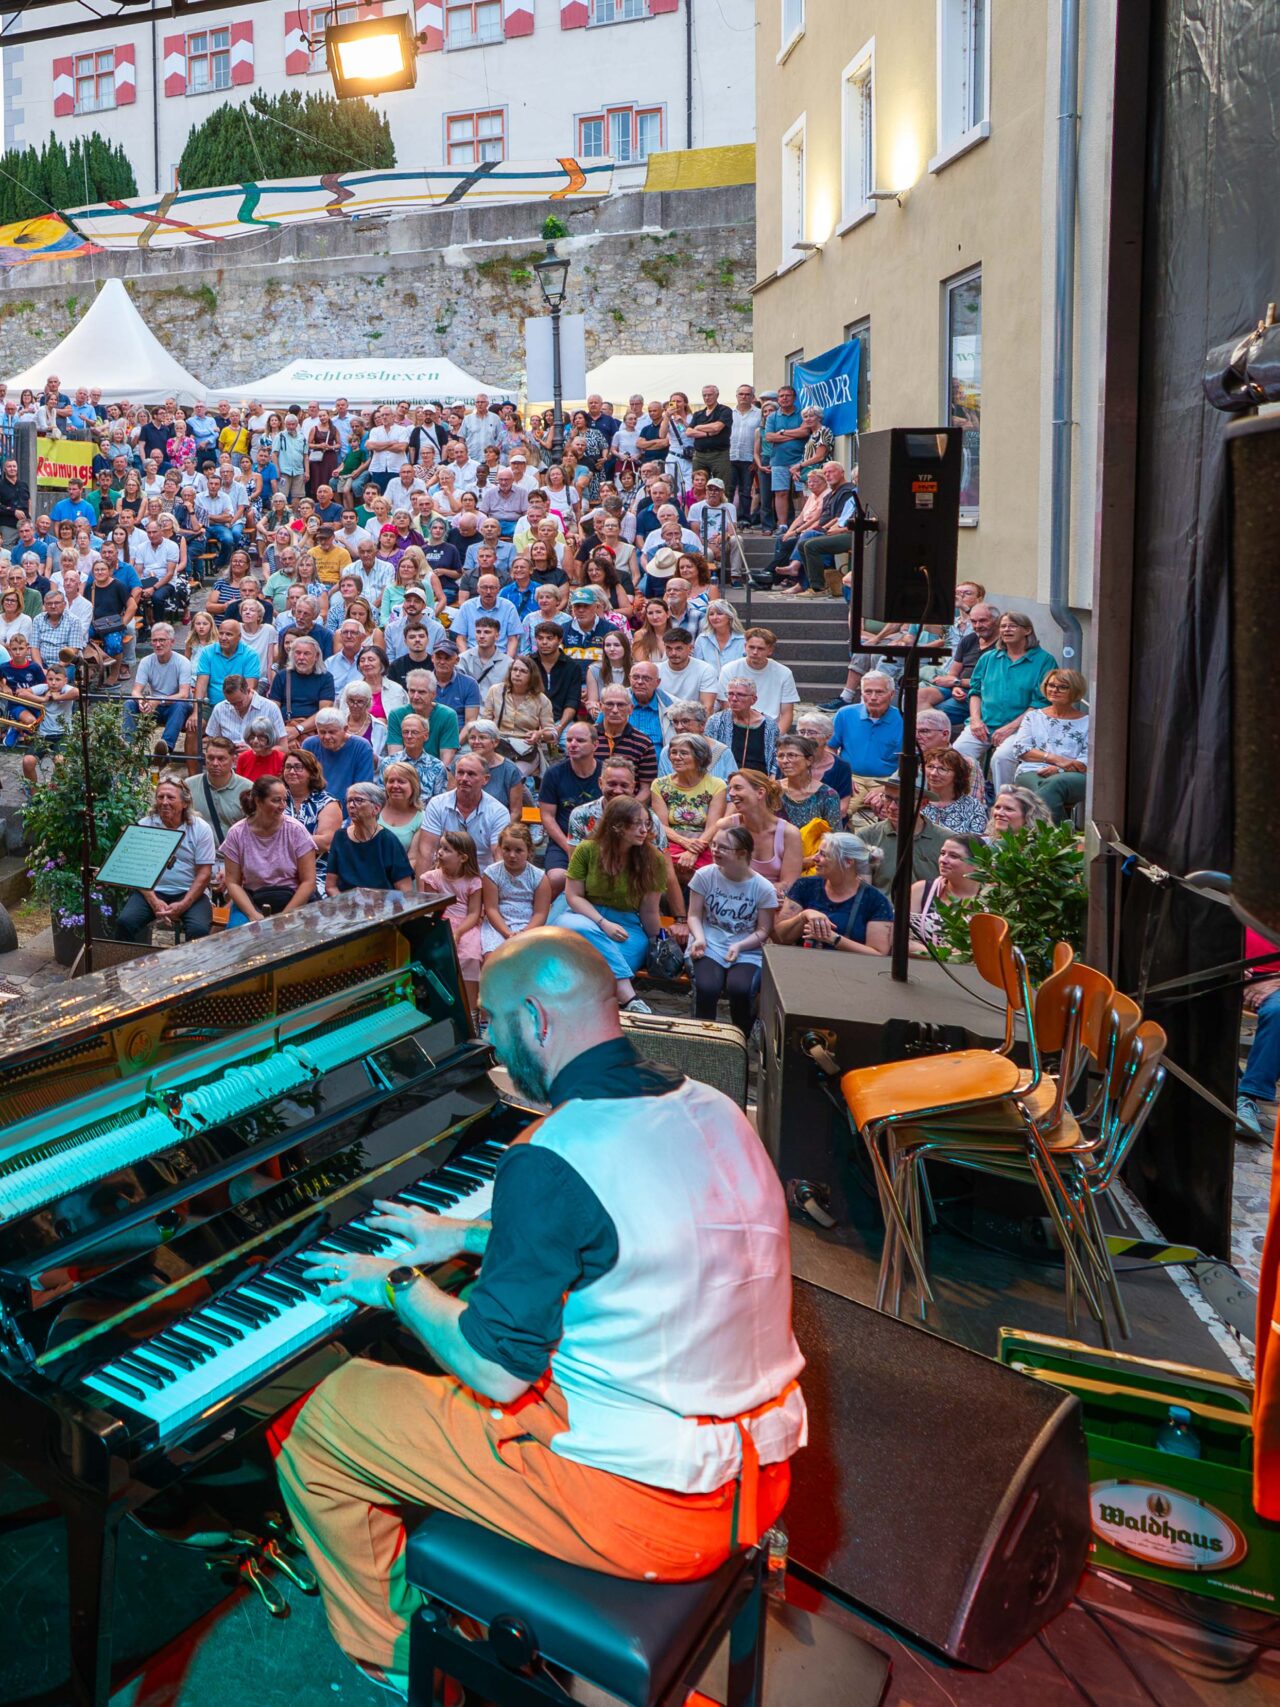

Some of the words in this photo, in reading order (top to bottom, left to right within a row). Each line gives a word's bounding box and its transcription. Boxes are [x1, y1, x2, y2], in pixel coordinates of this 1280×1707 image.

[292, 370, 440, 382] Schlosshexen
[36, 456, 93, 487] Räumungs
[705, 894, 757, 920] World
[1099, 1503, 1224, 1553] Waldhaus
